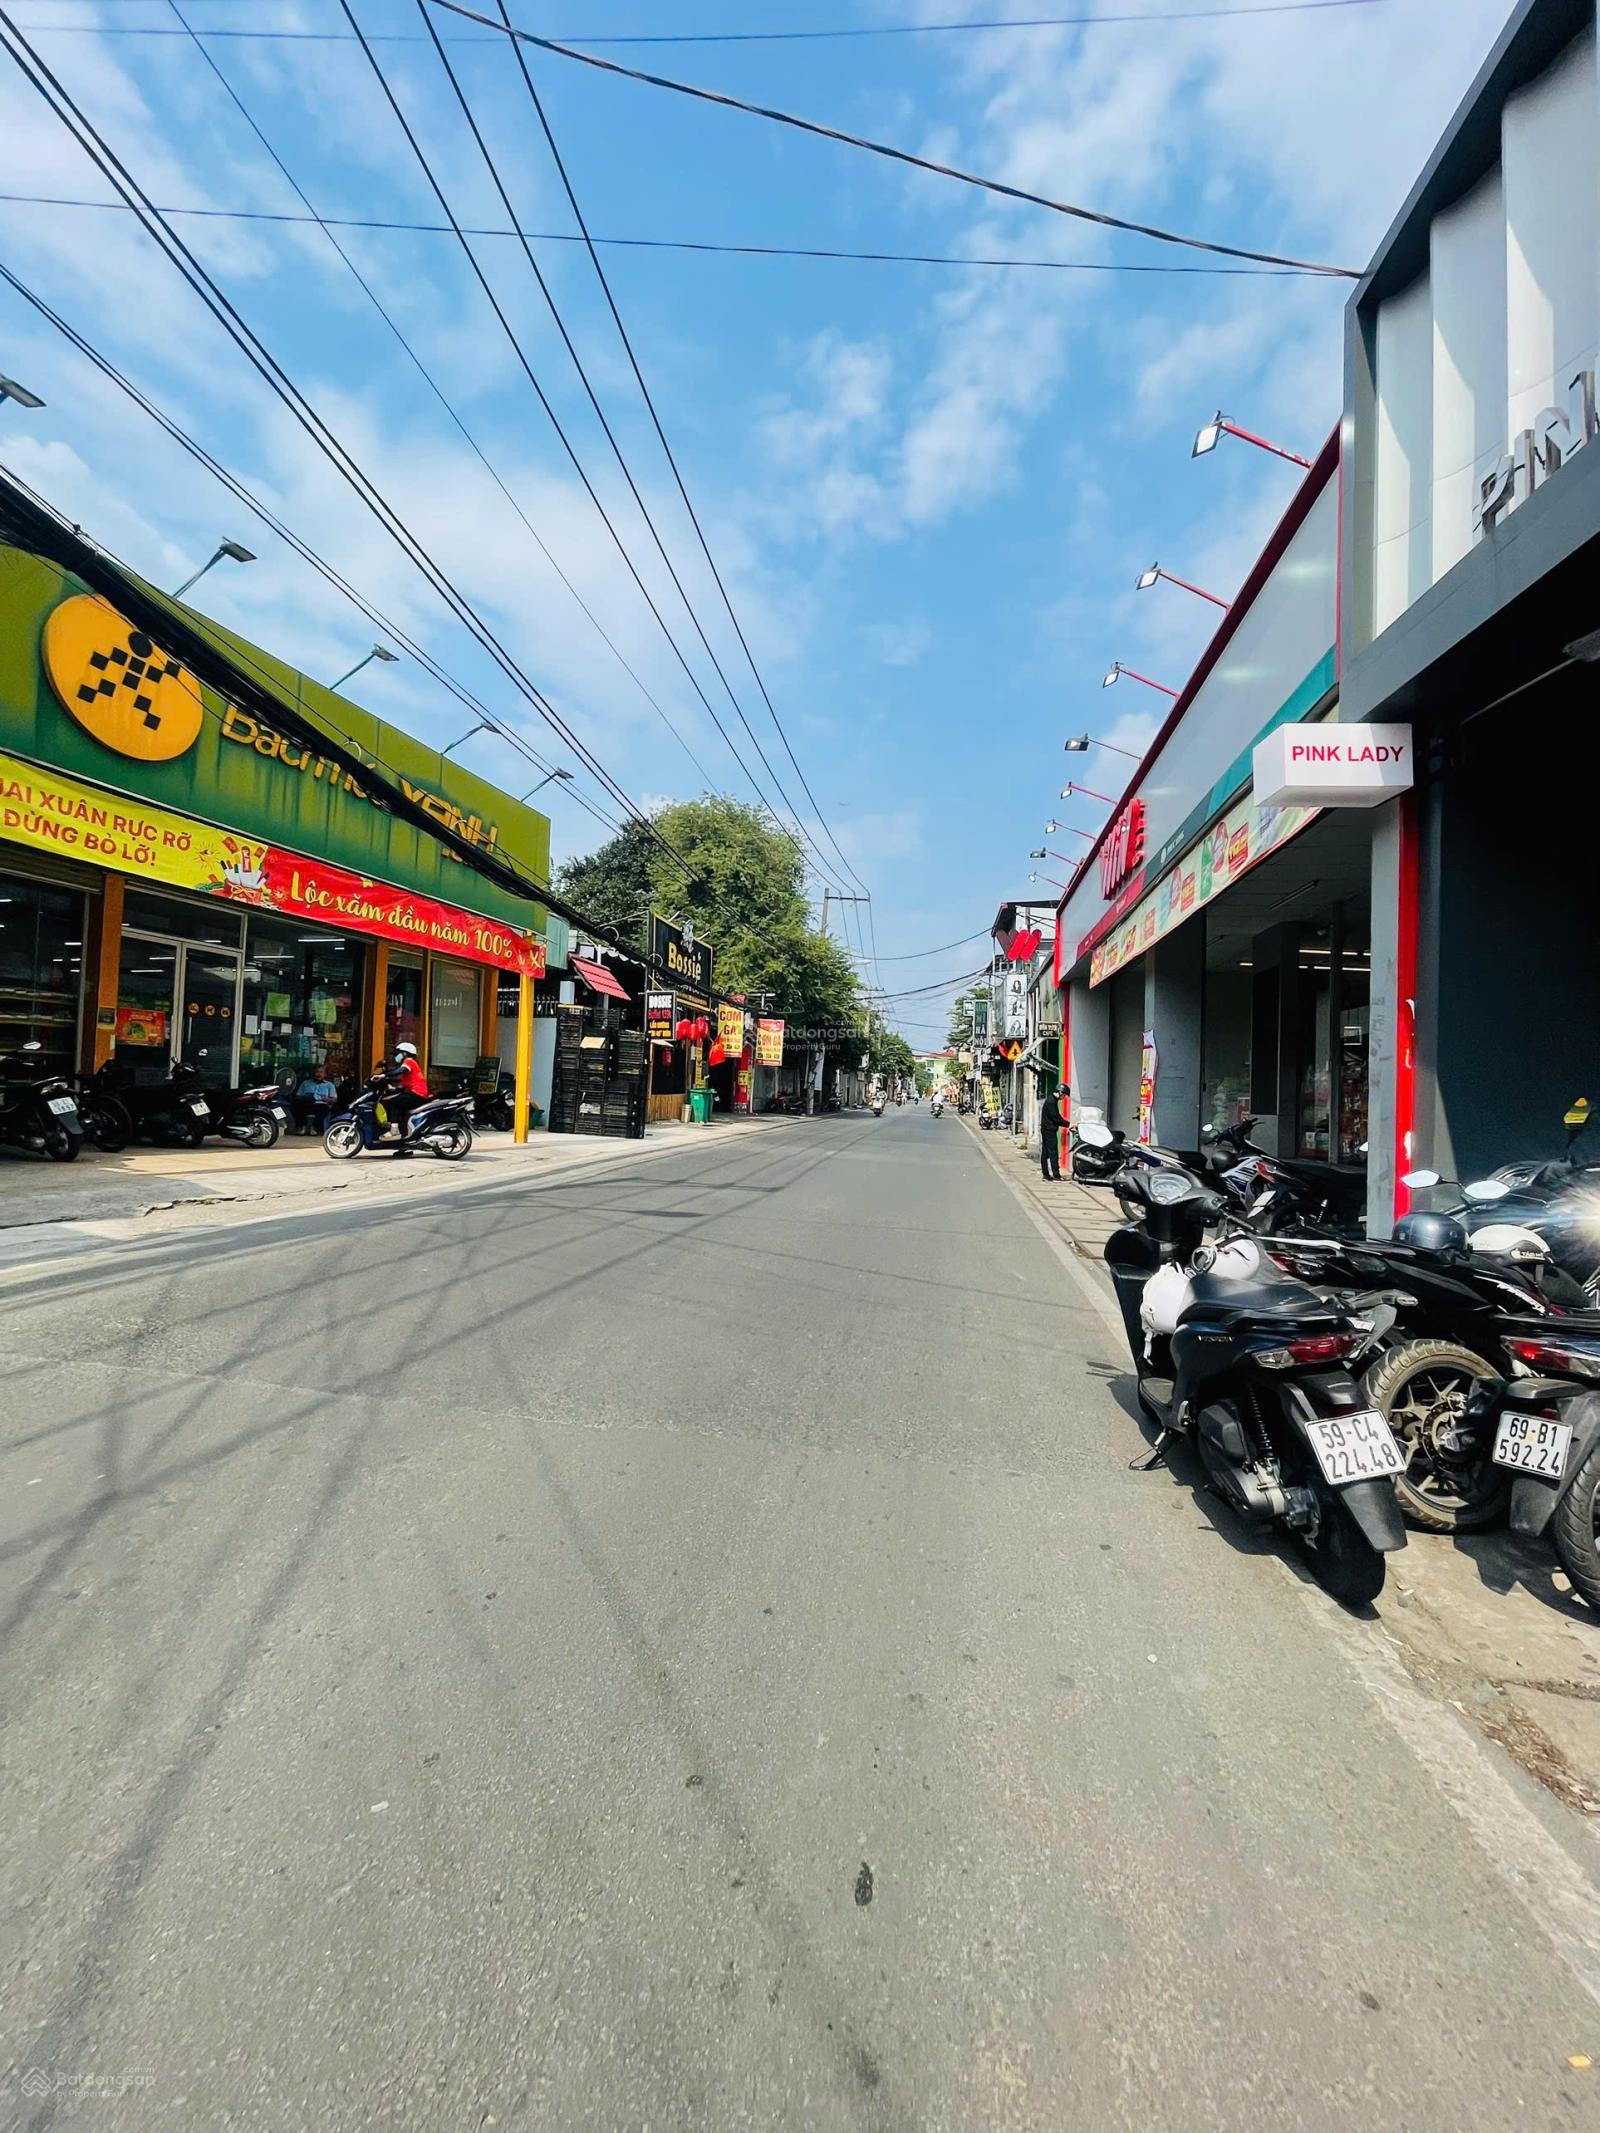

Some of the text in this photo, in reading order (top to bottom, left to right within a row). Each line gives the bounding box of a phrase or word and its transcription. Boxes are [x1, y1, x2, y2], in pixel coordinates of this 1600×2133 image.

[1292, 746, 1404, 762] PINK LADY
[3, 808, 157, 867] ĐỪNG BỎ LỠ!
[39, 790, 108, 828] XUÂN
[113, 814, 159, 842] RỰC
[162, 829, 192, 852] RỠ
[289, 871, 334, 909] Lộc
[335, 893, 386, 923] xăm
[387, 905, 428, 934] đầu
[430, 921, 470, 946] năm
[474, 928, 513, 958] 100%
[1317, 1418, 1379, 1450] 59-C4
[1324, 1442, 1398, 1480] 224.48
[1498, 1438, 1561, 1473] 592.24
